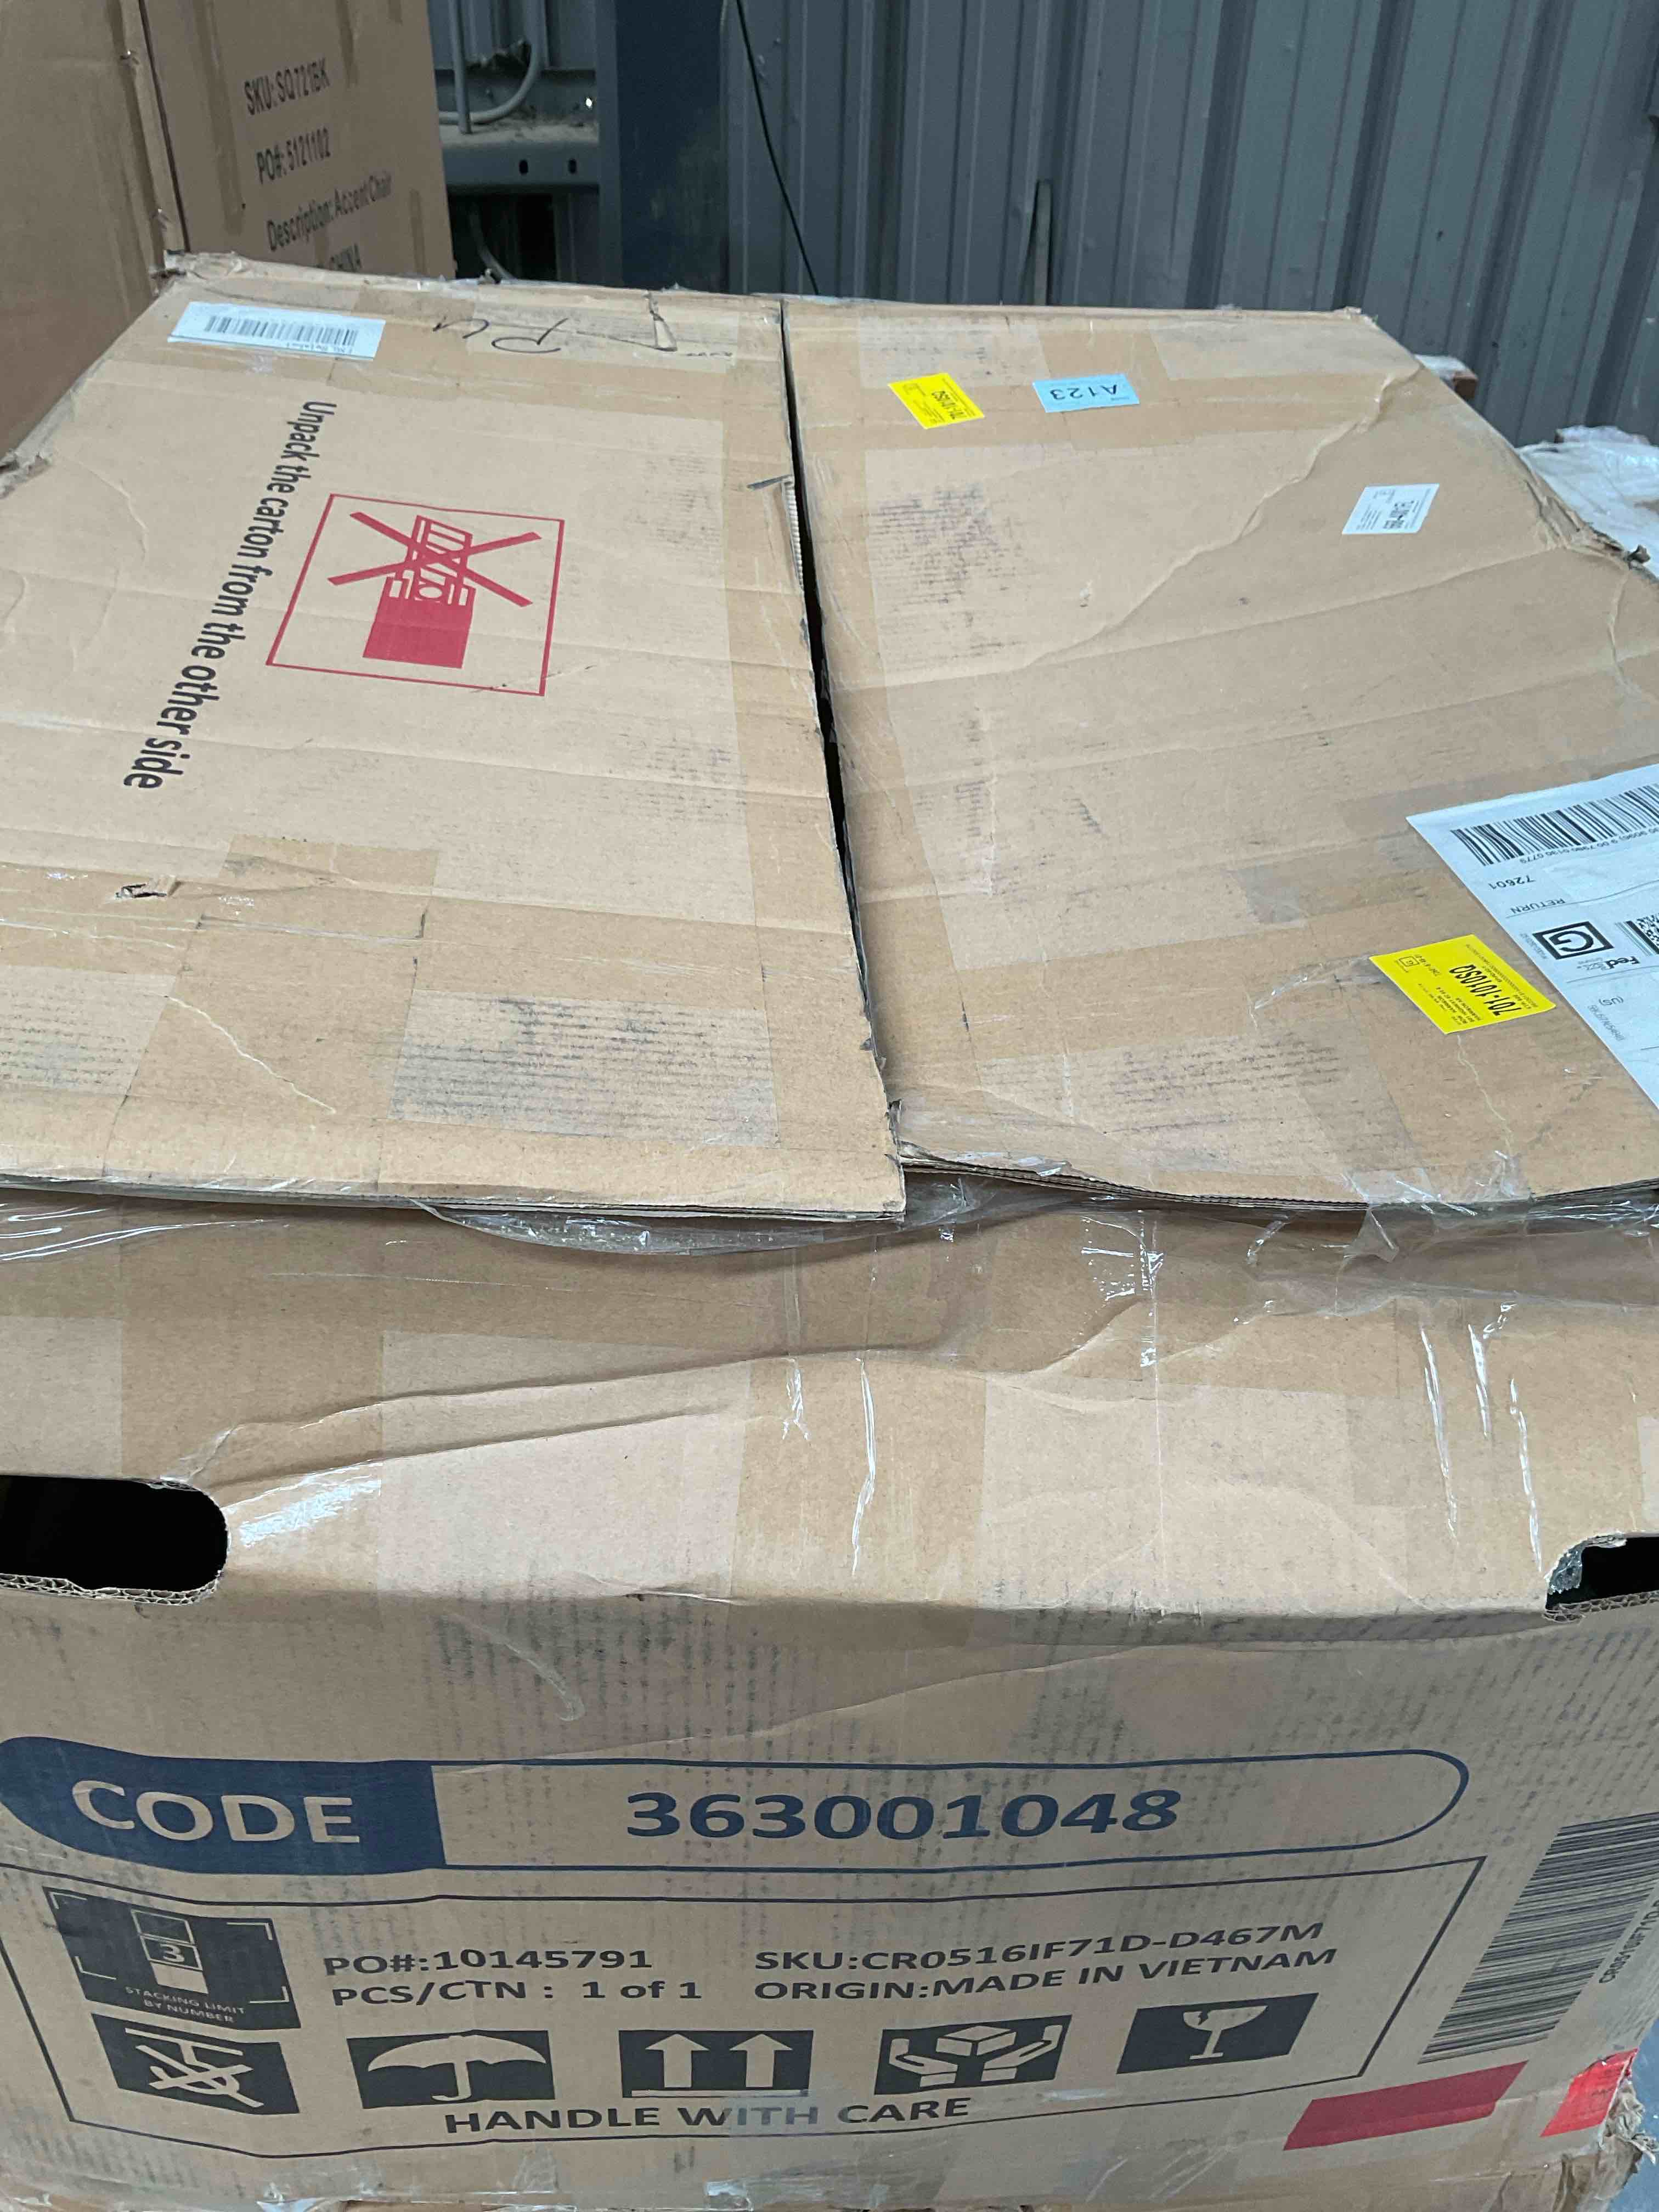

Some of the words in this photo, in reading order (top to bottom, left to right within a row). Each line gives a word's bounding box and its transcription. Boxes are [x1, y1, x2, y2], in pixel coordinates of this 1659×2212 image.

[1050, 384, 1118, 400] A123
[280, 402, 337, 461] Unpack
[267, 465, 311, 493] the
[237, 498, 289, 558] carton
[211, 565, 273, 616] from
[191, 622, 246, 659] the
[156, 665, 220, 735] other
[123, 737, 190, 788] side
[1488, 875, 1535, 889] 72601
[1510, 898, 1565, 914] RETURN
[1548, 930, 1594, 952] G
[1599, 995, 1624, 1007] (US)
[72, 1780, 360, 1843] CODE
[627, 1790, 1181, 1840] 363001048
[158, 1945, 185, 1963] 3
[755, 1922, 1324, 1971] SKU:CR0516IF71D-D467M
[323, 1949, 652, 1976] PO#:10145791
[754, 1971, 1065, 2000] ORIGIN:MADE
[1078, 1964, 1124, 1985] IN
[1138, 1948, 1338, 1978] VIETNAM
[125, 1986, 199, 2007] STACKING
[205, 2002, 246, 2014] LIMIT
[331, 1980, 526, 2006] PCS/CTN
[582, 1981, 606, 1999] 1
[619, 1980, 667, 2000] of
[679, 1981, 702, 2000] 1
[144, 2000, 162, 2009] BY
[167, 2004, 234, 2023] NUMBER
[445, 2107, 660, 2135] HANDLE
[678, 2106, 819, 2127] WITH
[838, 2097, 972, 2124] CARE
